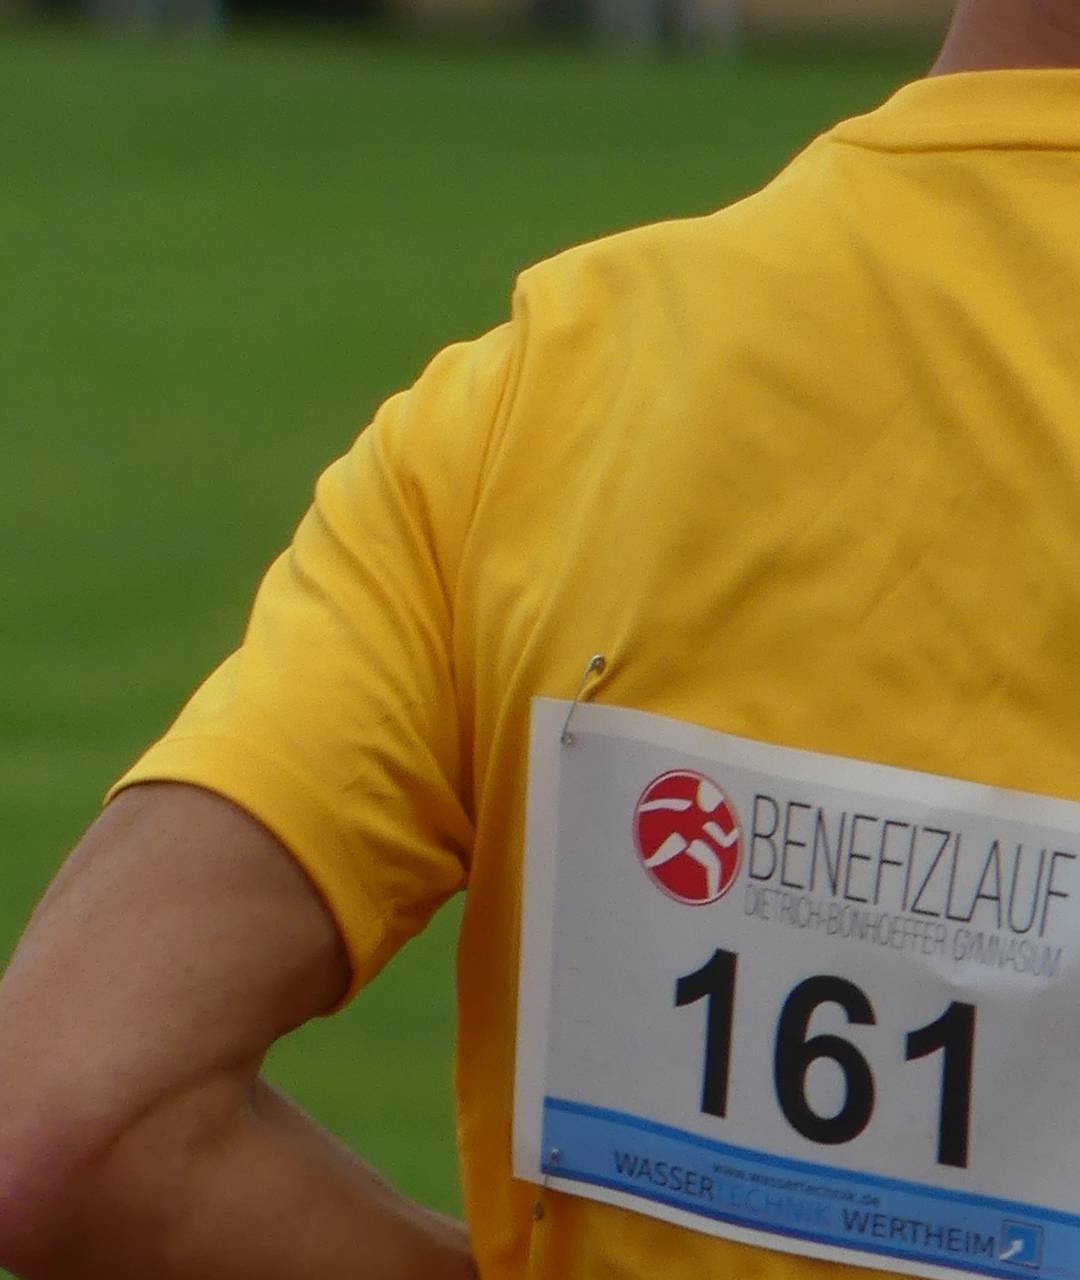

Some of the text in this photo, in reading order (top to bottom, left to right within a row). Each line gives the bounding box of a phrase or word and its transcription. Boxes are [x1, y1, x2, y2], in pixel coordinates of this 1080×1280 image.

[748, 793, 1077, 938] BENEFIZLAUF
[744, 884, 1062, 978] DIETRICH-BONHOEFFER GYMNASIUM
[674, 947, 978, 1170] 161
[841, 1207, 995, 1258] WERTHEIM
